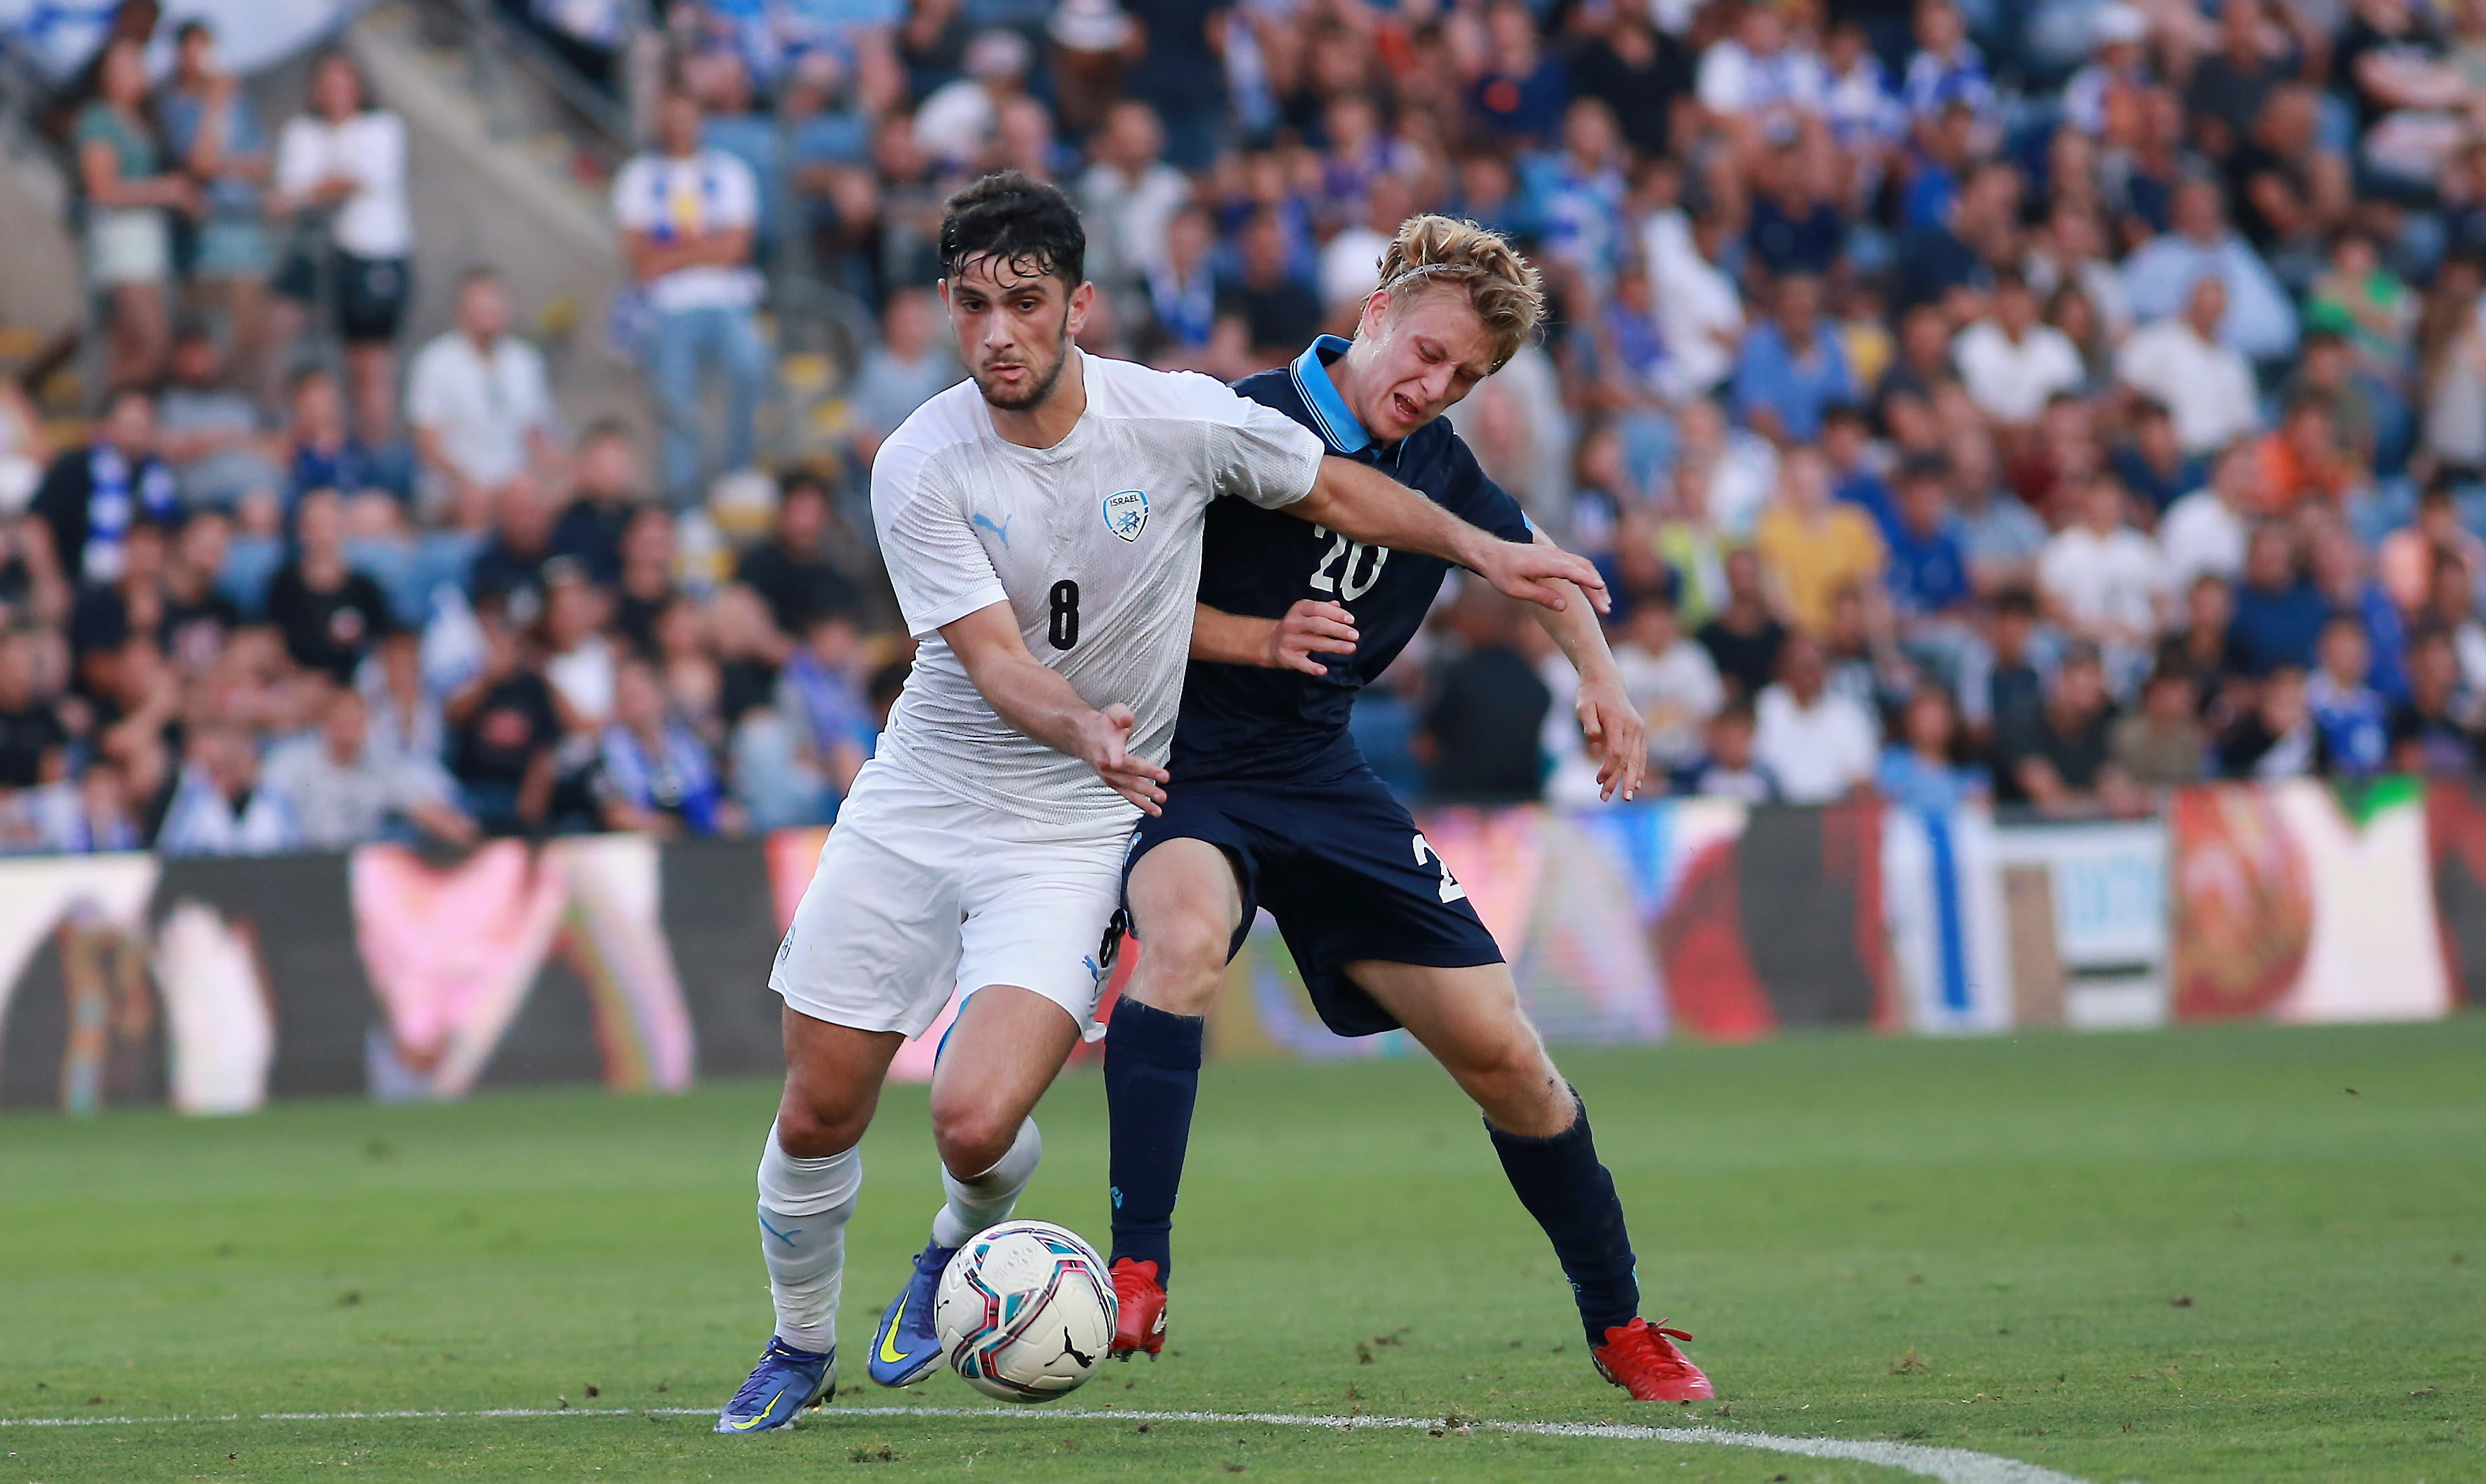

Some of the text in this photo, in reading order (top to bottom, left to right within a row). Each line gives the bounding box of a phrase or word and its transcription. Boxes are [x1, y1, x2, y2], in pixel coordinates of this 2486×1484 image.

[1110, 494, 1140, 507] ISRAEL
[1309, 524, 1389, 602] 20
[1048, 579, 1079, 651] 8
[1099, 908, 1127, 968] 8
